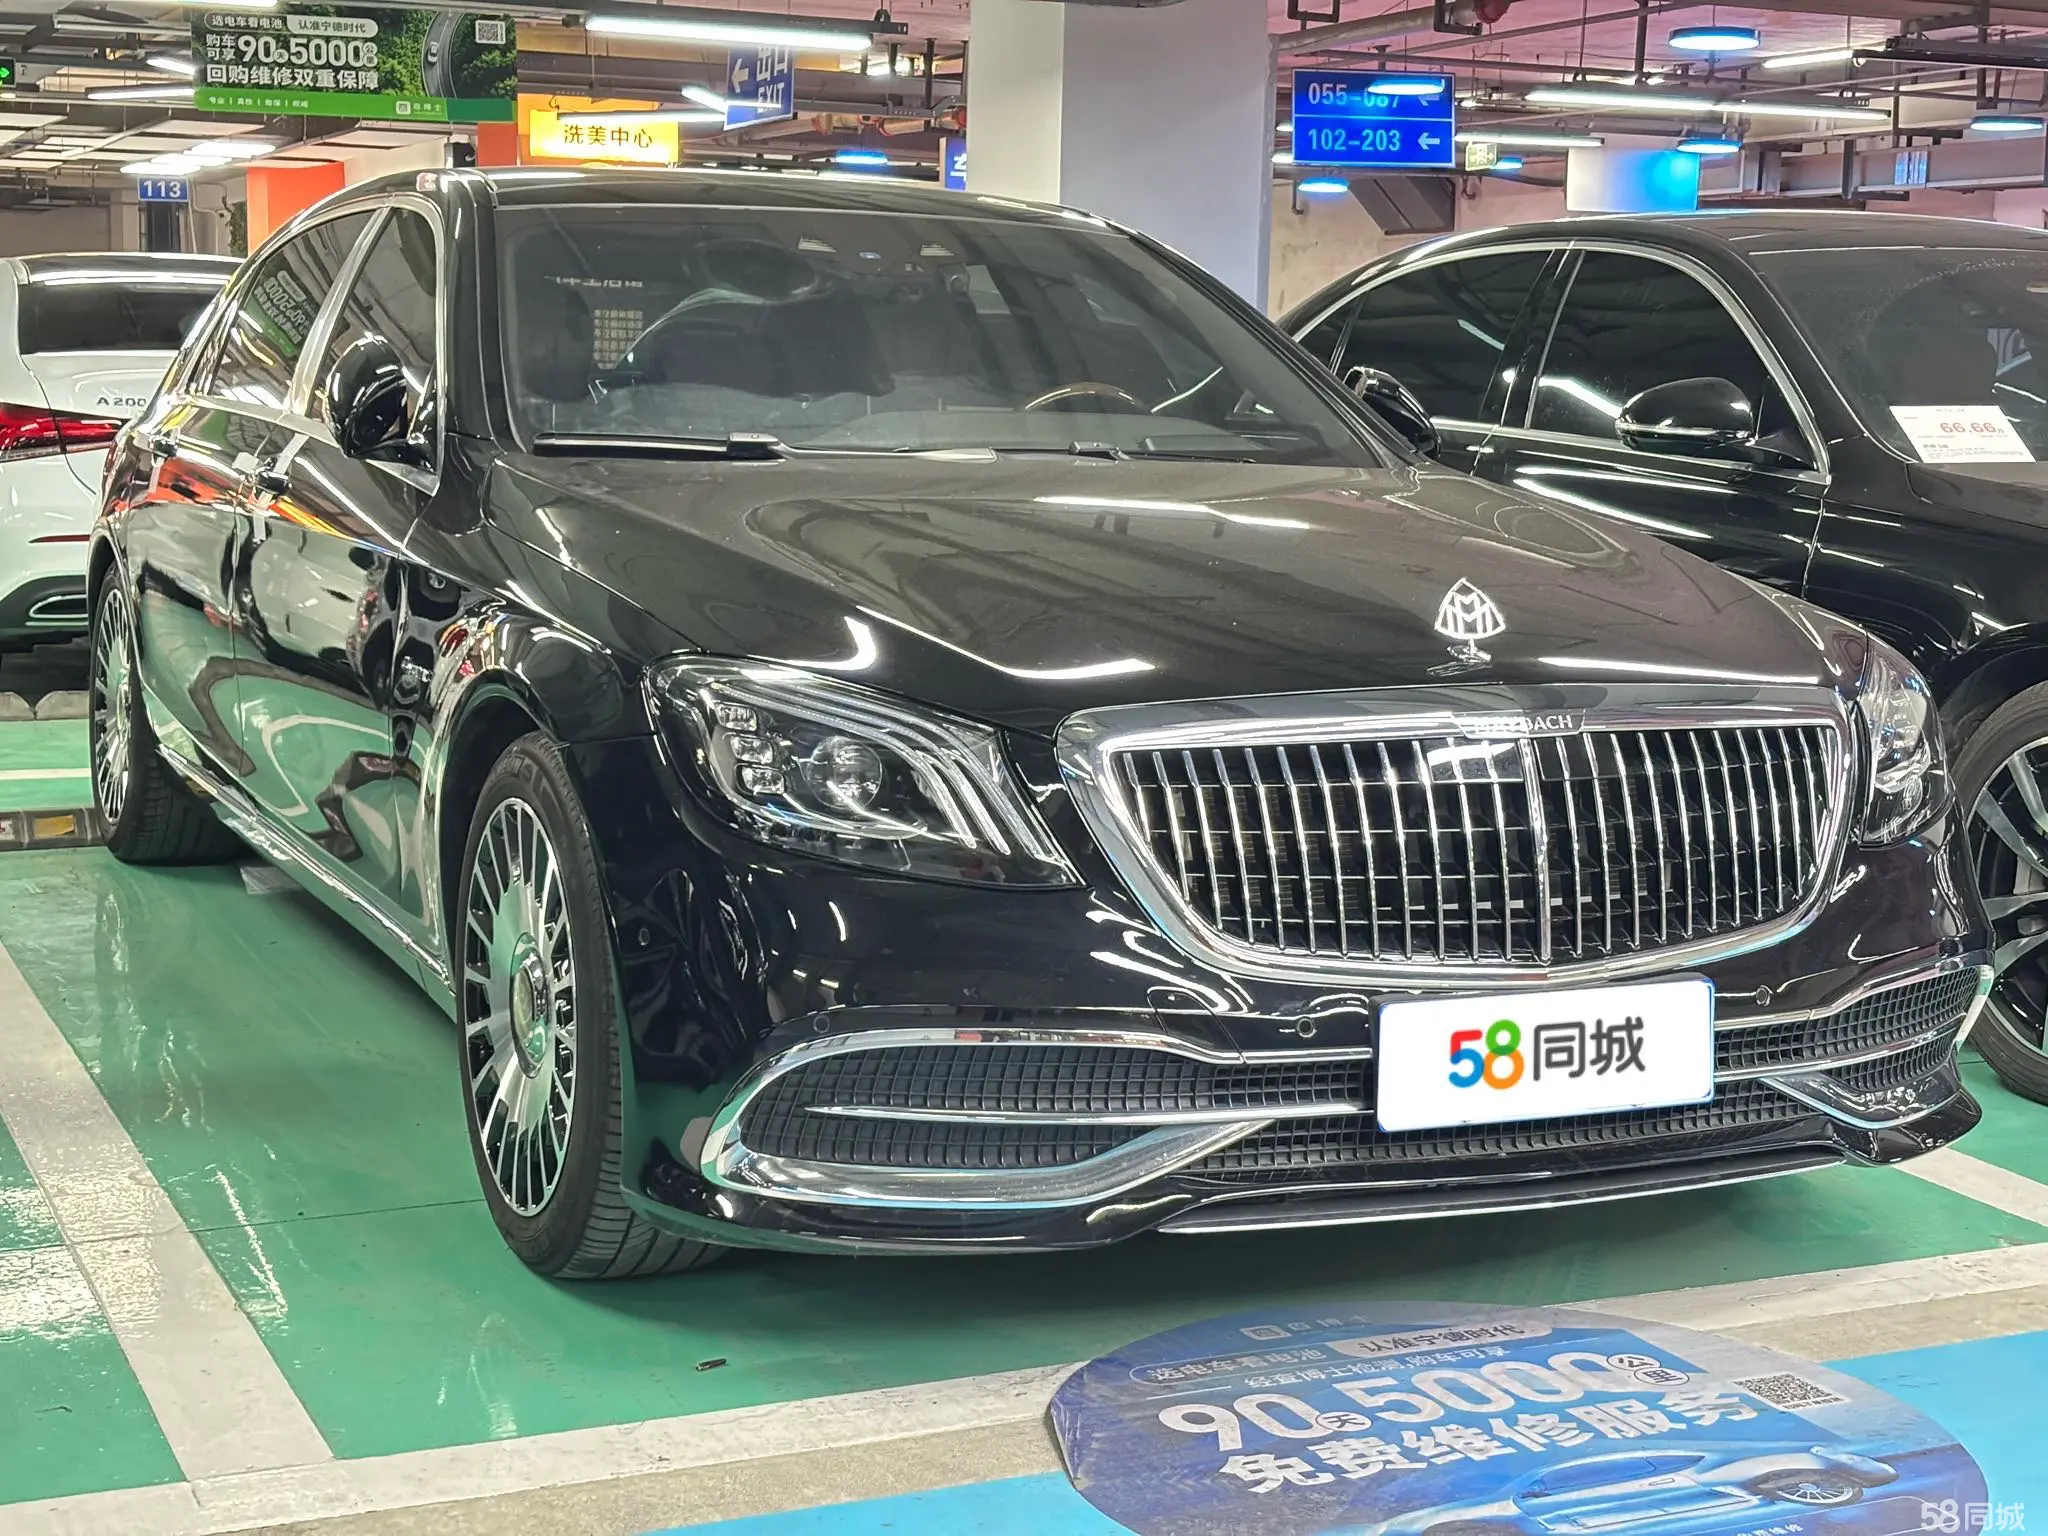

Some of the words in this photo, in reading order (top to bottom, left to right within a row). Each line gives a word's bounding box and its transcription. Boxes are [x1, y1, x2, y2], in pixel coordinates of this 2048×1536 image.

[211, 14, 283, 30] 选电车看电池
[298, 19, 367, 34] 认准宁德时代
[206, 33, 236, 48] 购车
[207, 47, 236, 61] 可享
[206, 63, 379, 90] 回购维修双重保障
[758, 82, 785, 106] EXIT
[564, 123, 653, 149] 洗美中心
[1308, 128, 1401, 151] 102-203
[143, 179, 181, 198] 113
[1358, 1322, 1526, 1354] 认准宁德时代
[1148, 1348, 1327, 1381] 选电车看电池
[1219, 1391, 1759, 1494] 免费维修服务
